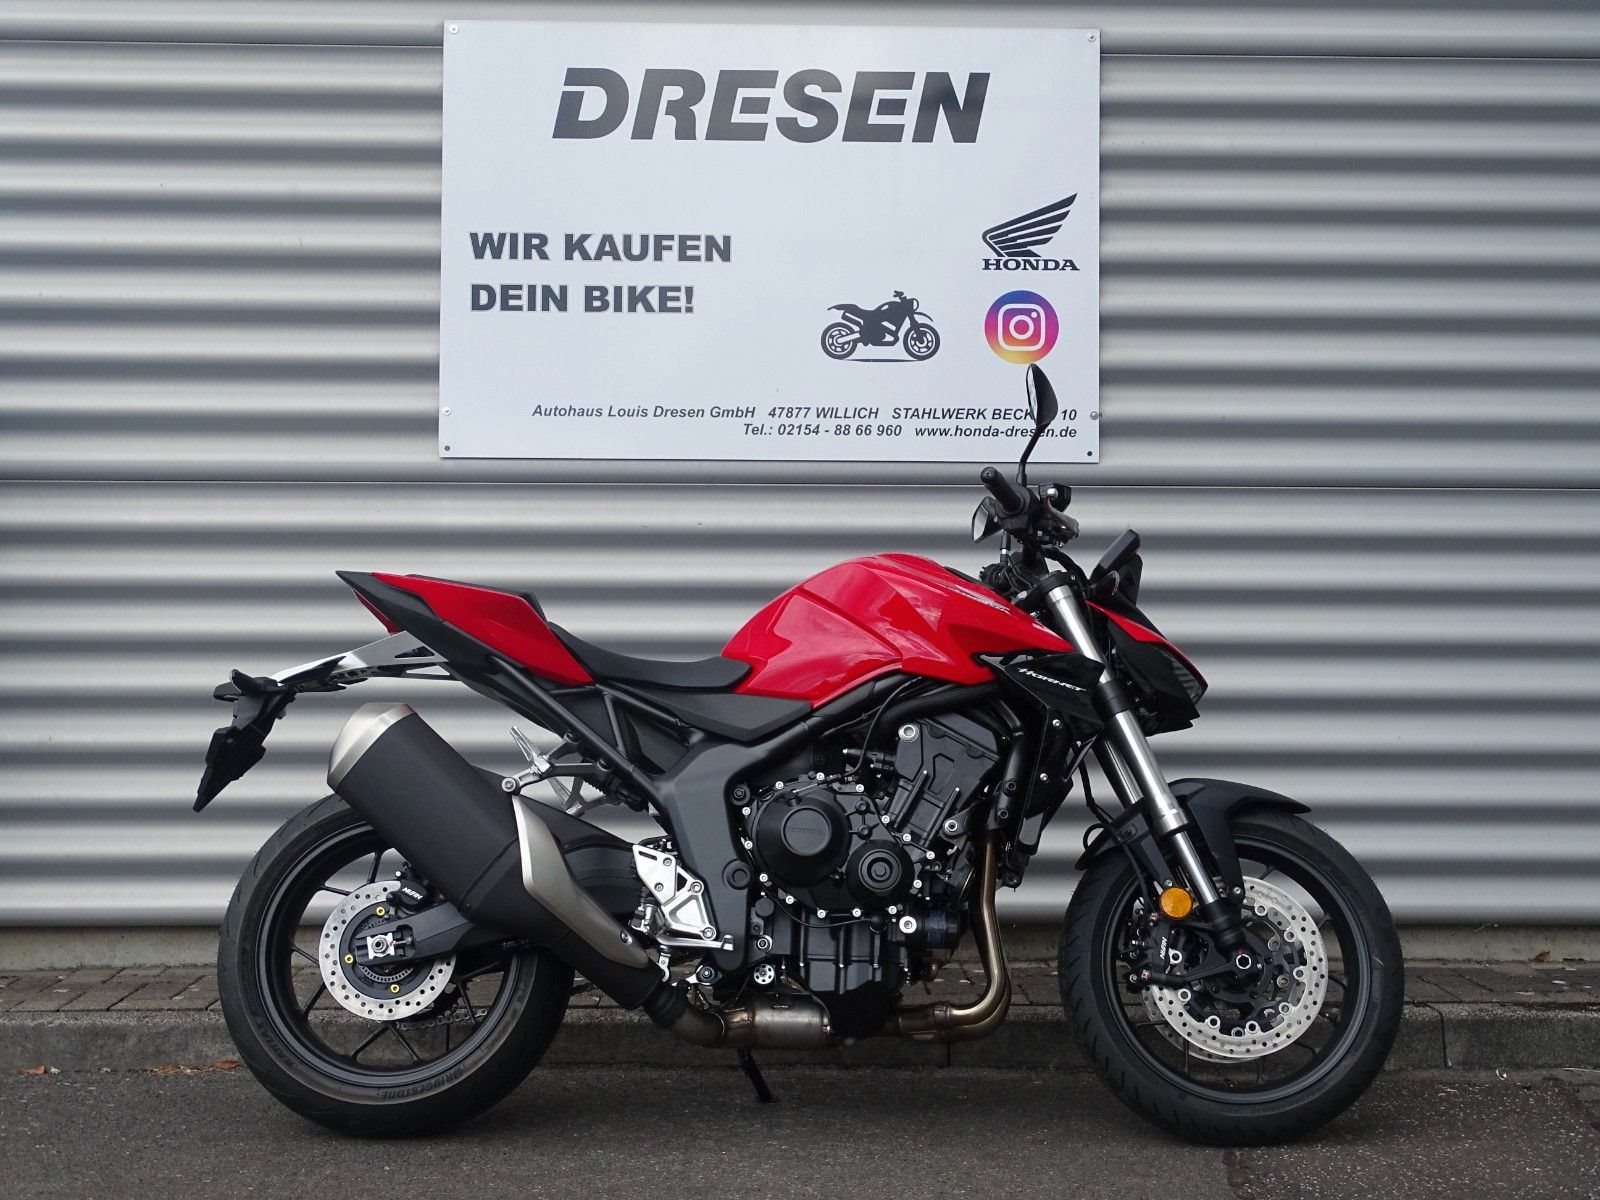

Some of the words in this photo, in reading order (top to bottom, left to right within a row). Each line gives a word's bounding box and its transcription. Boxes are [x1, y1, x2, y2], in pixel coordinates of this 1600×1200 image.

[552, 68, 991, 143] DRESEN
[470, 232, 550, 261] WIR
[565, 233, 733, 263] KAUFEN
[982, 258, 1080, 271] HONDA
[470, 284, 568, 312] DEIN
[584, 285, 694, 314] BIKE!
[532, 404, 603, 417] Autohaus
[608, 405, 649, 418] Louis
[653, 405, 705, 418] Dresen
[710, 406, 756, 419] GmbH
[768, 406, 812, 419] 47877
[816, 407, 880, 420] WILLICH
[891, 407, 988, 420] STAHLWERK
[1061, 408, 1077, 421] 10
[743, 423, 773, 436] Tel.:
[778, 423, 821, 436] 02154
[834, 424, 851, 436] 88
[855, 424, 873, 436] 66
[877, 424, 903, 437] 960
